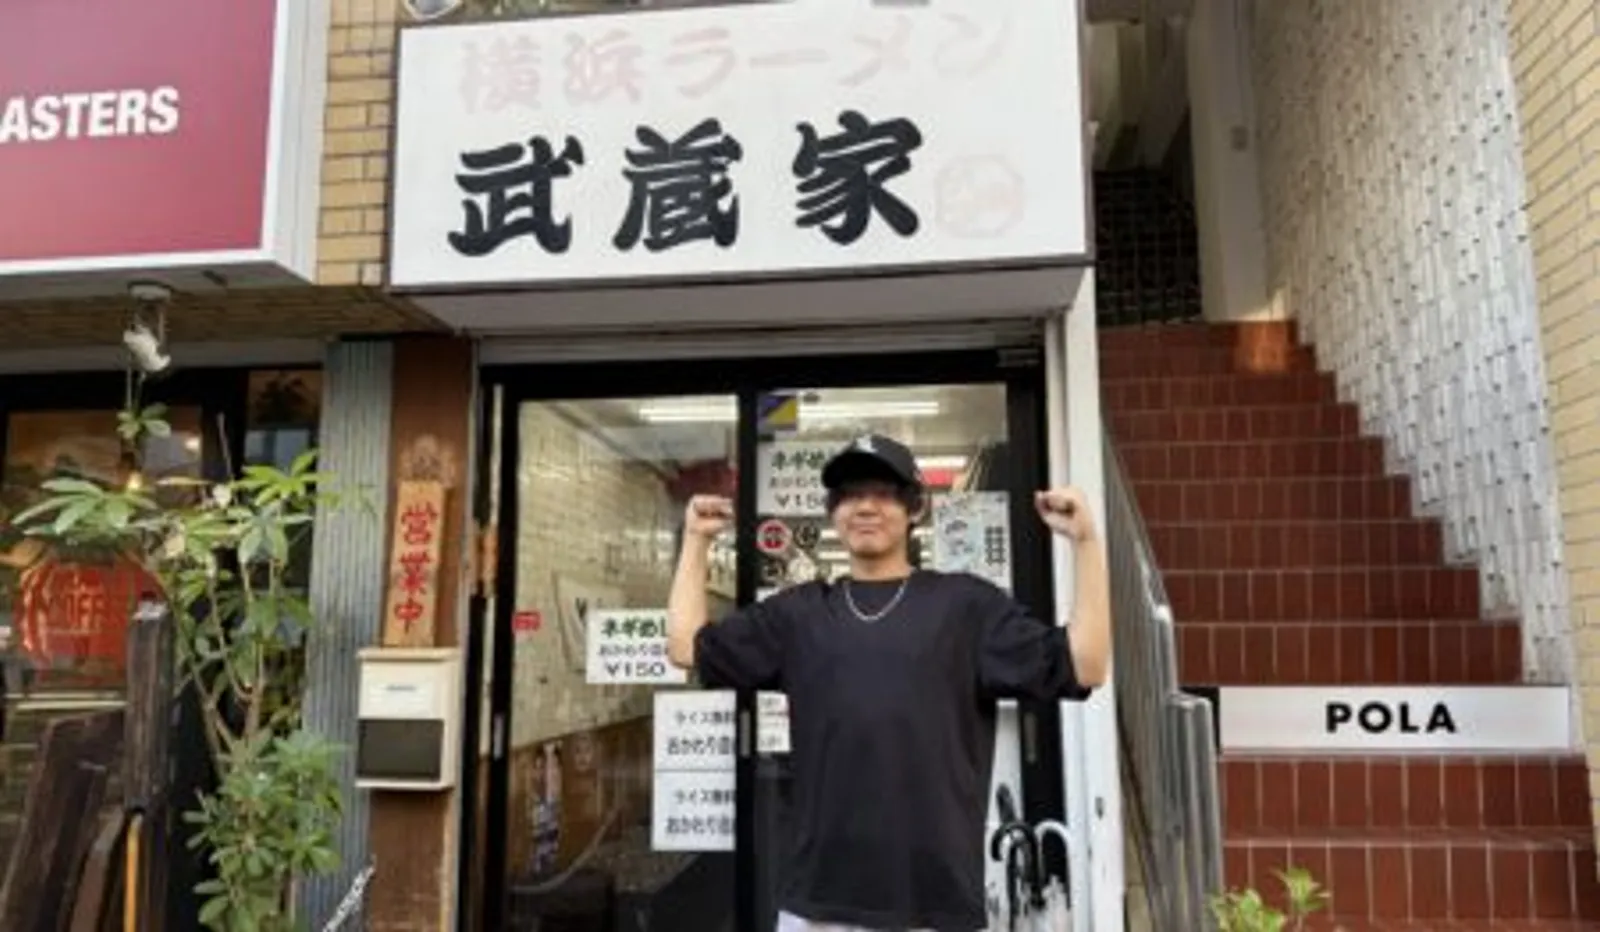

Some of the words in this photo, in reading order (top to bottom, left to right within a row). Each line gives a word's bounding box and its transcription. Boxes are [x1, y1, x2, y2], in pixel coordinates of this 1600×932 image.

[459, 12, 1010, 111] 横浜ラーメン
[0, 86, 180, 143] ASTERS
[448, 110, 923, 257] 武蔵家
[394, 501, 438, 635] 営業中
[605, 660, 666, 677] ¥150
[1326, 702, 1456, 734] POLA
